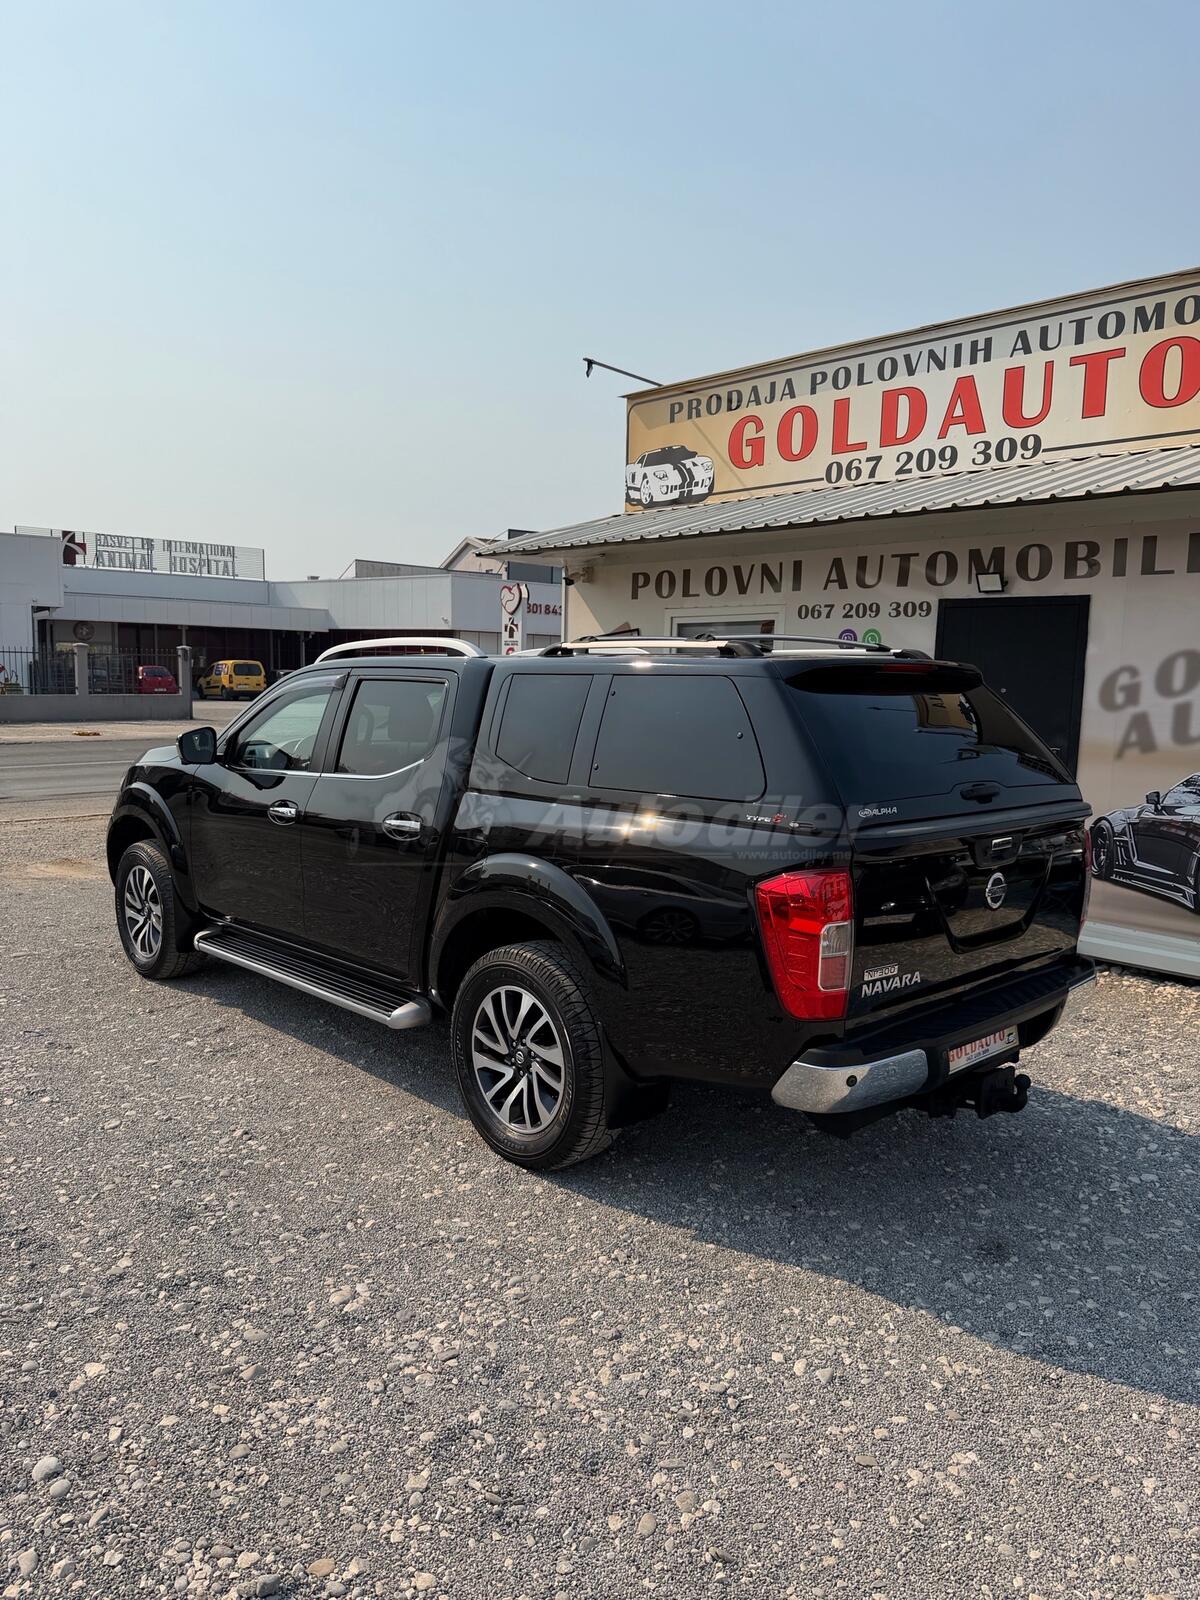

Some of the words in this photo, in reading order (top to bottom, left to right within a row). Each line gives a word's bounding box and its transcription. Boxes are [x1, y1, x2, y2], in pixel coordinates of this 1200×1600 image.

[669, 378, 797, 424] PRODAJA
[809, 337, 994, 396] POLOVNIH
[1010, 294, 1200, 358] AUTOMO
[728, 336, 1200, 470] GOLDAUTO
[825, 455, 883, 485] 067
[895, 445, 959, 476] 209
[971, 434, 1043, 466] 309
[97, 550, 157, 571] ANIMAL
[169, 555, 239, 577] HOSPITAL
[631, 559, 803, 600] POLOVNI
[797, 603, 835, 620] 067
[842, 602, 881, 619] 209
[888, 601, 932, 618] 309
[872, 806, 898, 817] ALPHA
[861, 971, 921, 998] NAVARA
